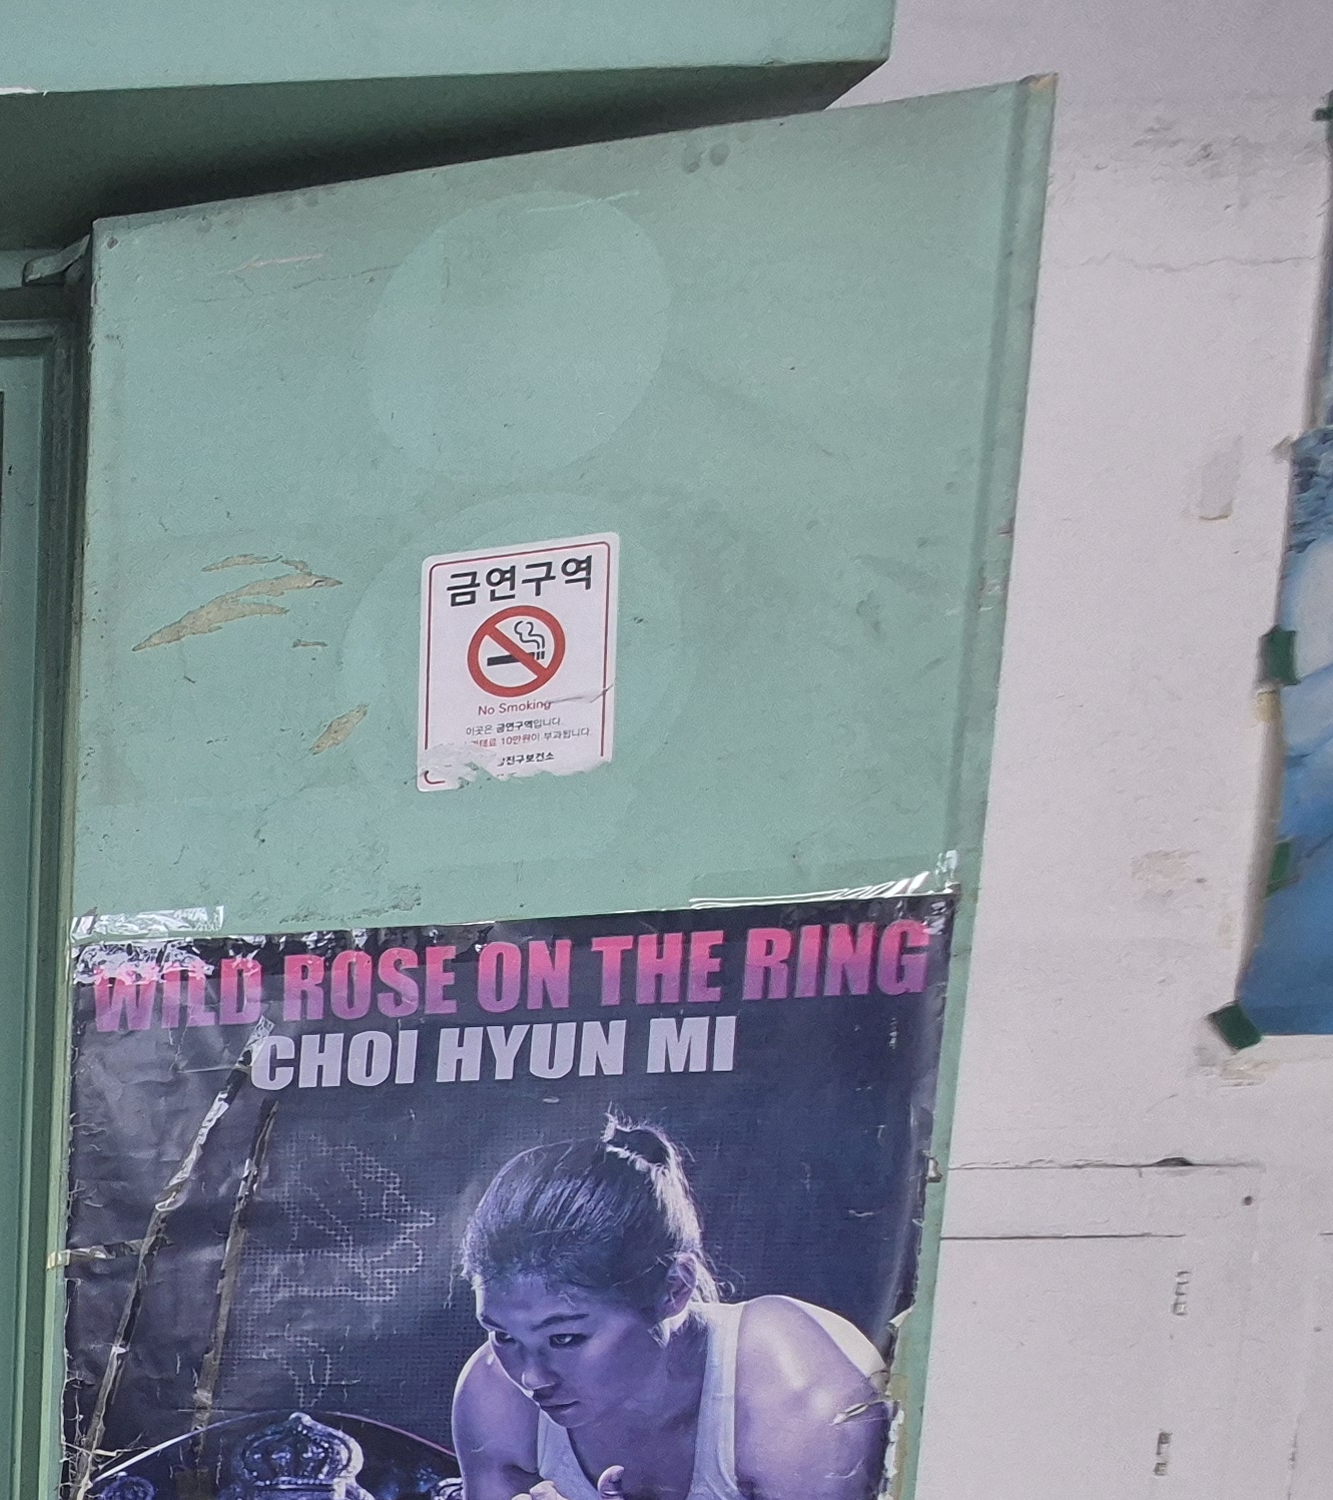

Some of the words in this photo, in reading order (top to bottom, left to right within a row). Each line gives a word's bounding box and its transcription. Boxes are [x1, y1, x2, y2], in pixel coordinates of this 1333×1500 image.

[446, 555, 593, 607] 금연구역
[466, 724, 493, 736] 이곳은
[478, 705, 495, 716] No
[498, 700, 552, 714] Smoking
[92, 950, 263, 1033] WILD
[279, 943, 461, 1024] ROSE
[477, 937, 576, 1014] ON
[589, 930, 728, 1006] THE
[742, 918, 934, 1002] RING
[250, 1028, 421, 1093] CHOI
[435, 1020, 631, 1085] HYUN
[646, 1014, 738, 1076] MI
